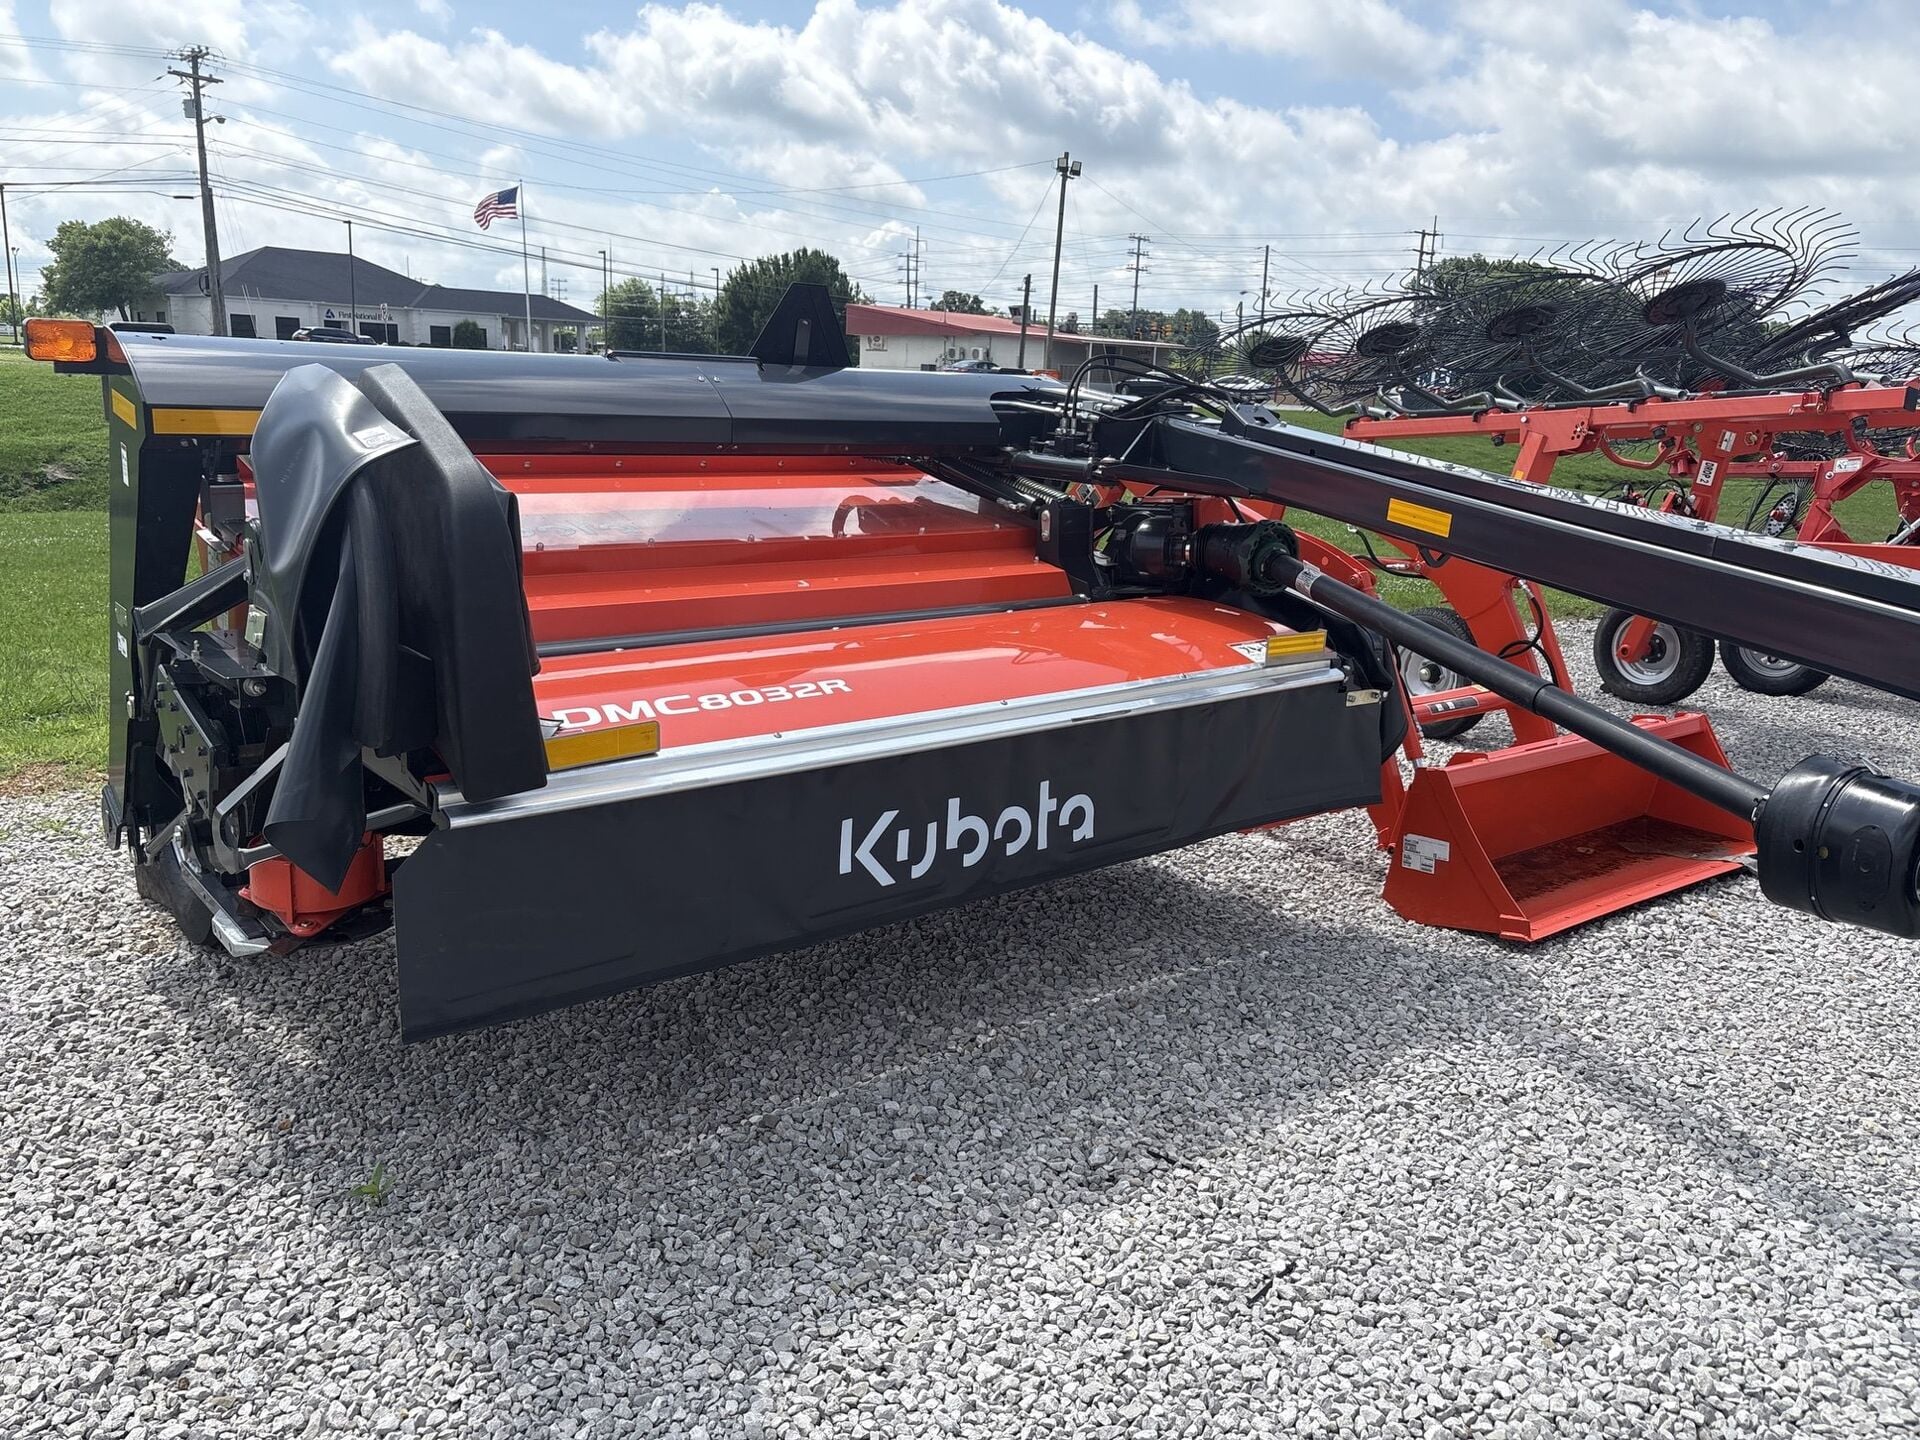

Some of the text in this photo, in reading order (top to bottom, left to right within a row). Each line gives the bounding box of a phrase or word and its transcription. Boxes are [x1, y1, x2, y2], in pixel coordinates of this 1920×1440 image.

[338, 311, 352, 319] First
[1702, 462, 1714, 479] DROP
[552, 678, 852, 728] DMC8032R
[839, 780, 1095, 887] Kubota
